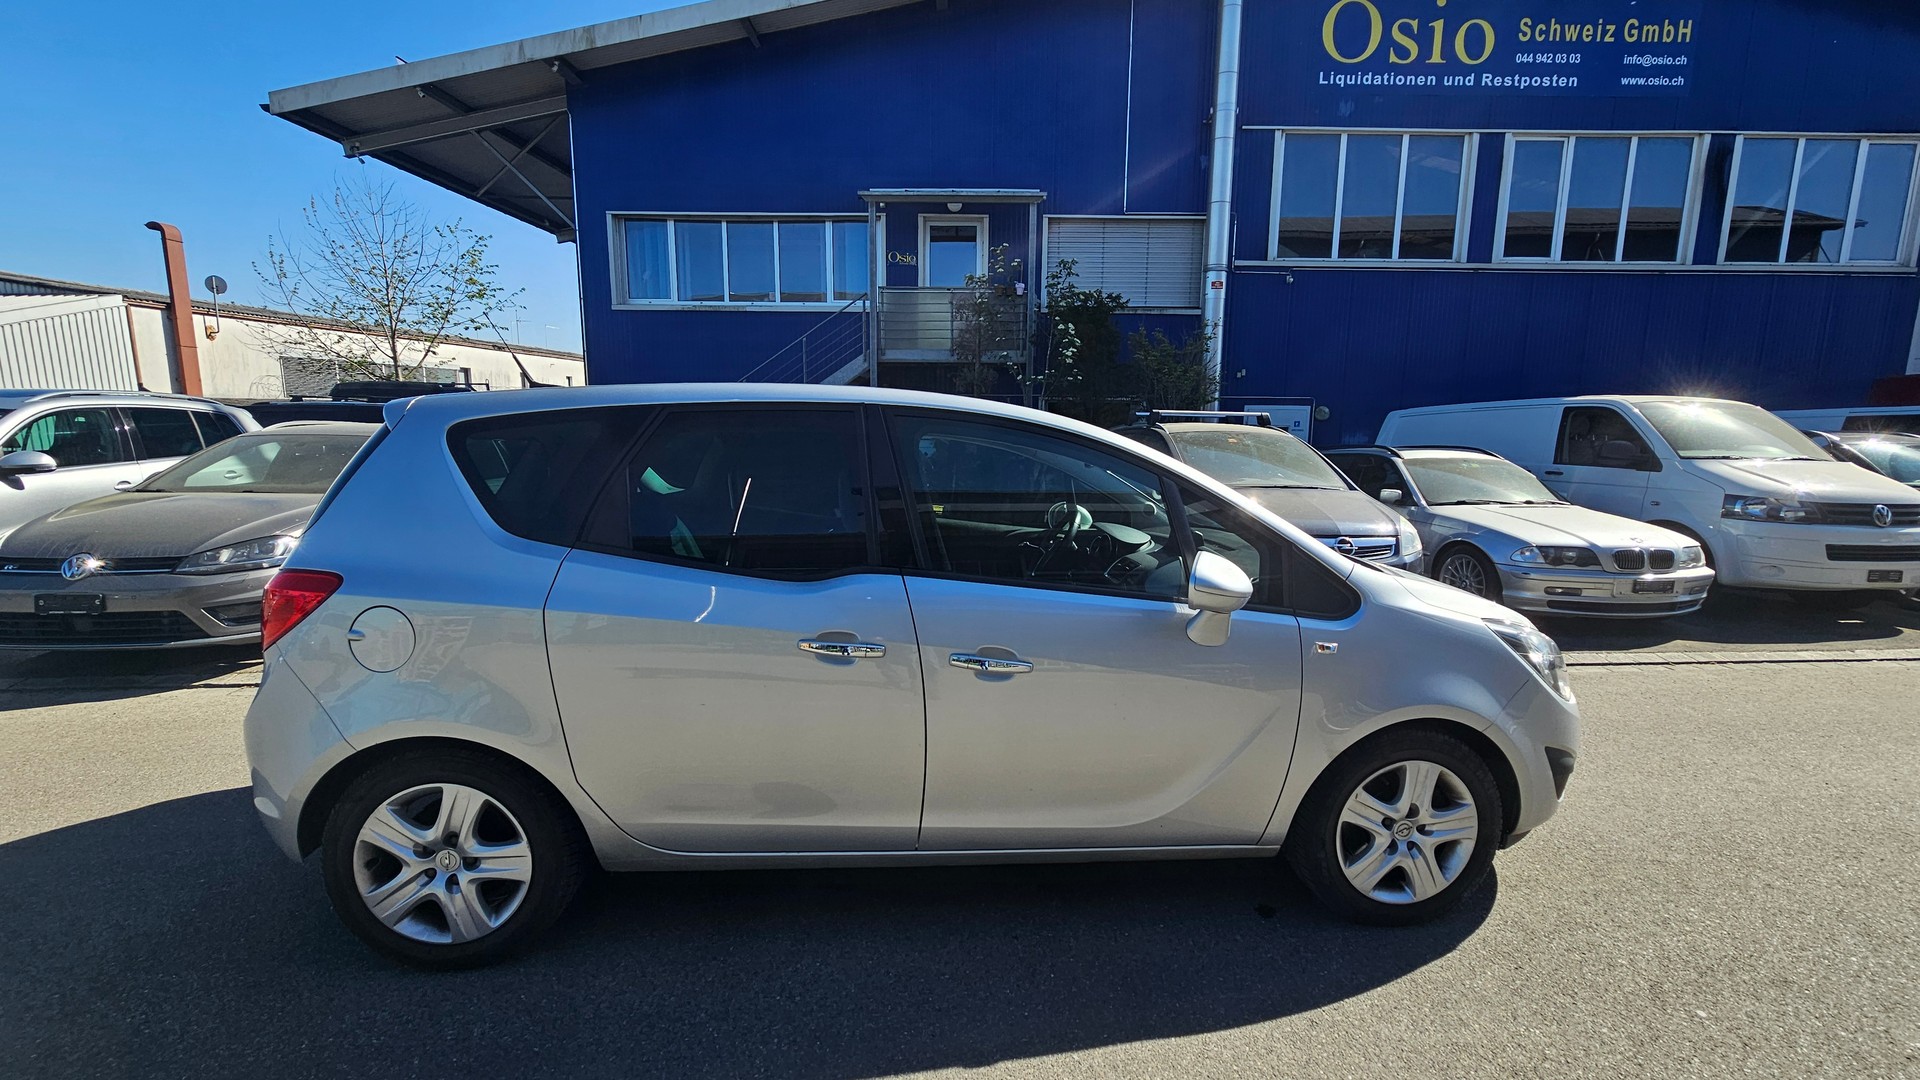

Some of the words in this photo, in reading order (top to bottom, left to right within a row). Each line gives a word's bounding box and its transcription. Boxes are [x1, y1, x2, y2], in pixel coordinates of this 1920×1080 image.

[1322, 0, 1495, 65] Osio
[1518, 17, 1616, 42] Schweiz
[1623, 18, 1693, 43] GmbH
[1515, 53, 1534, 64] 044
[1535, 53, 1553, 64] 942
[1555, 53, 1567, 64] 03
[1569, 53, 1581, 64] 03
[1623, 54, 1688, 67] info@osio.ch
[1319, 71, 1436, 87] Liquidationen
[1443, 73, 1475, 87] und
[1481, 73, 1578, 89] Restposten
[1621, 76, 1684, 86] www.osio.ch
[888, 251, 916, 263] Osio
